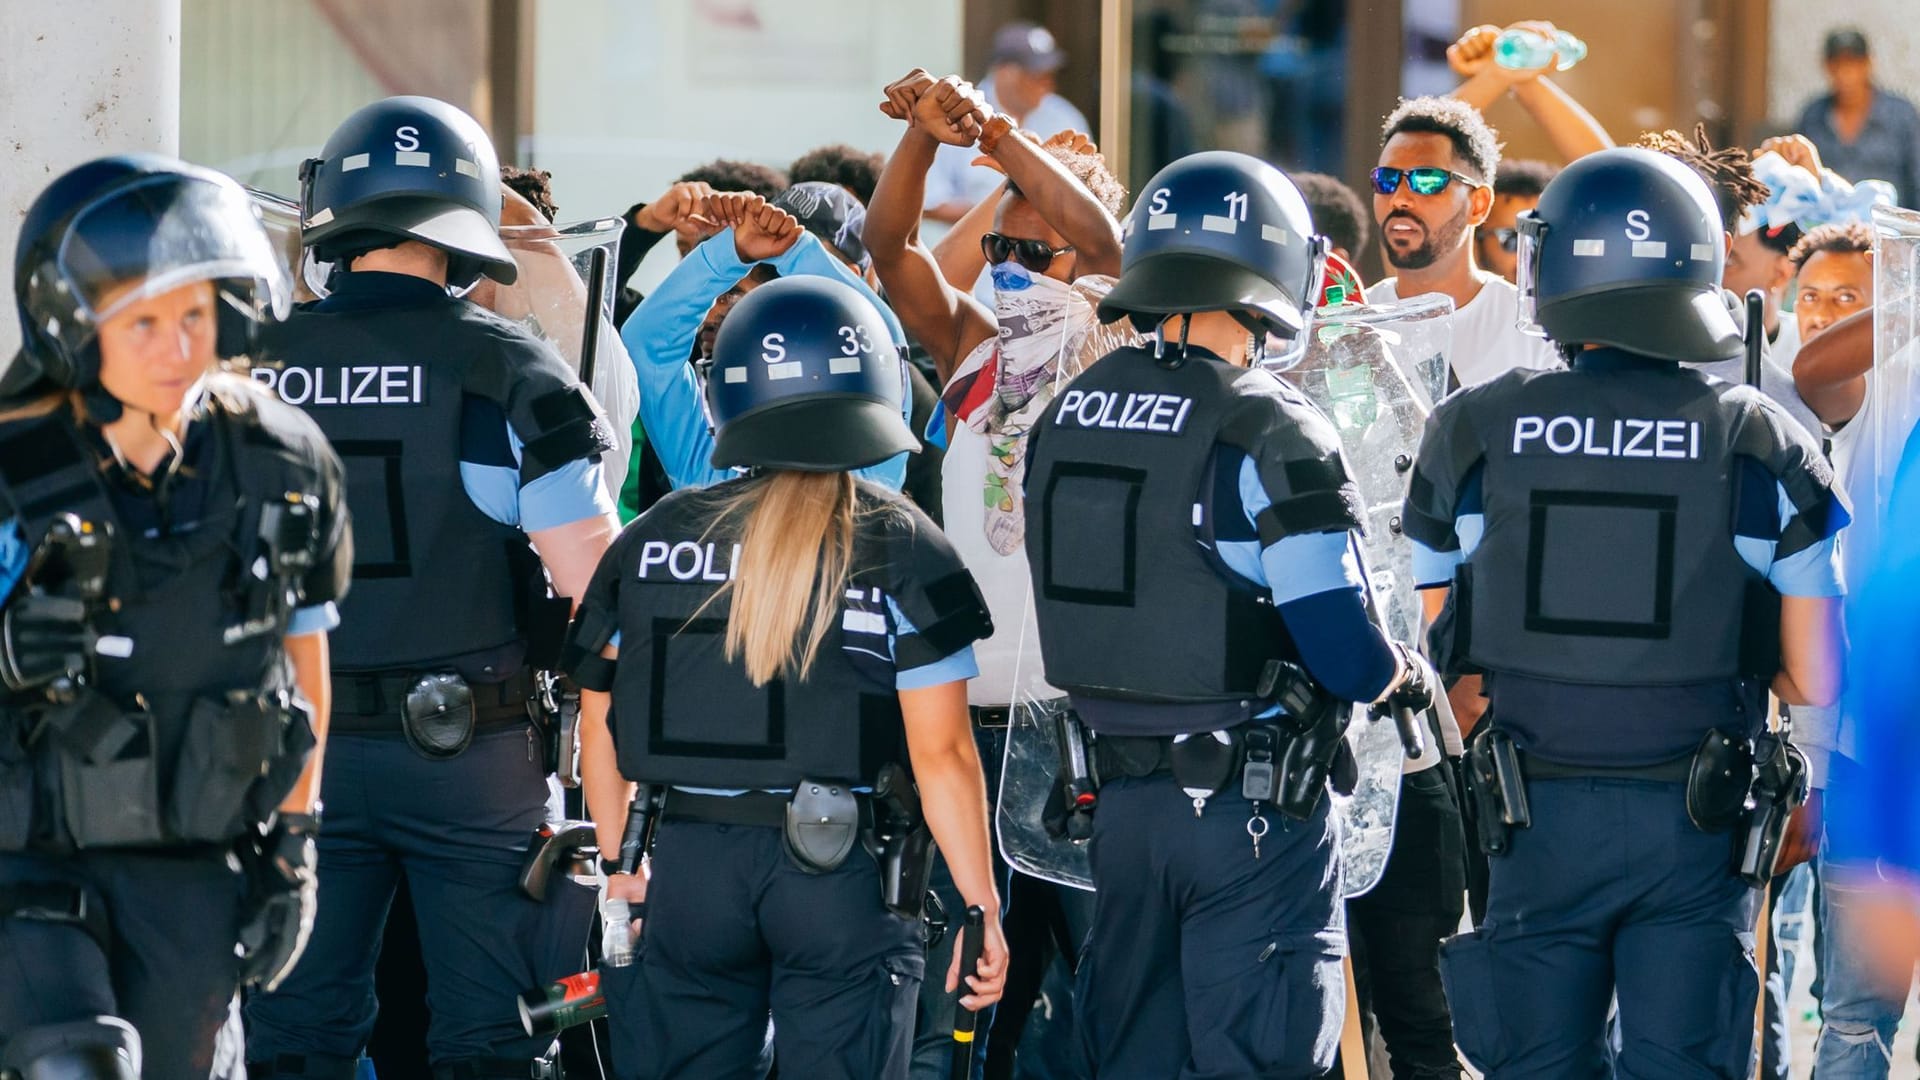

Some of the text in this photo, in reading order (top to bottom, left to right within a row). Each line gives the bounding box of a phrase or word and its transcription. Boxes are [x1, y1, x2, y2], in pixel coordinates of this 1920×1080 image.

[394, 126, 419, 152] S
[1148, 188, 1248, 222] S 11
[1625, 209, 1650, 241] S
[762, 325, 874, 363] S 33
[250, 366, 422, 405] POLIZEI
[1055, 390, 1192, 433] POLIZEI
[1513, 416, 1700, 459] POLIZEI
